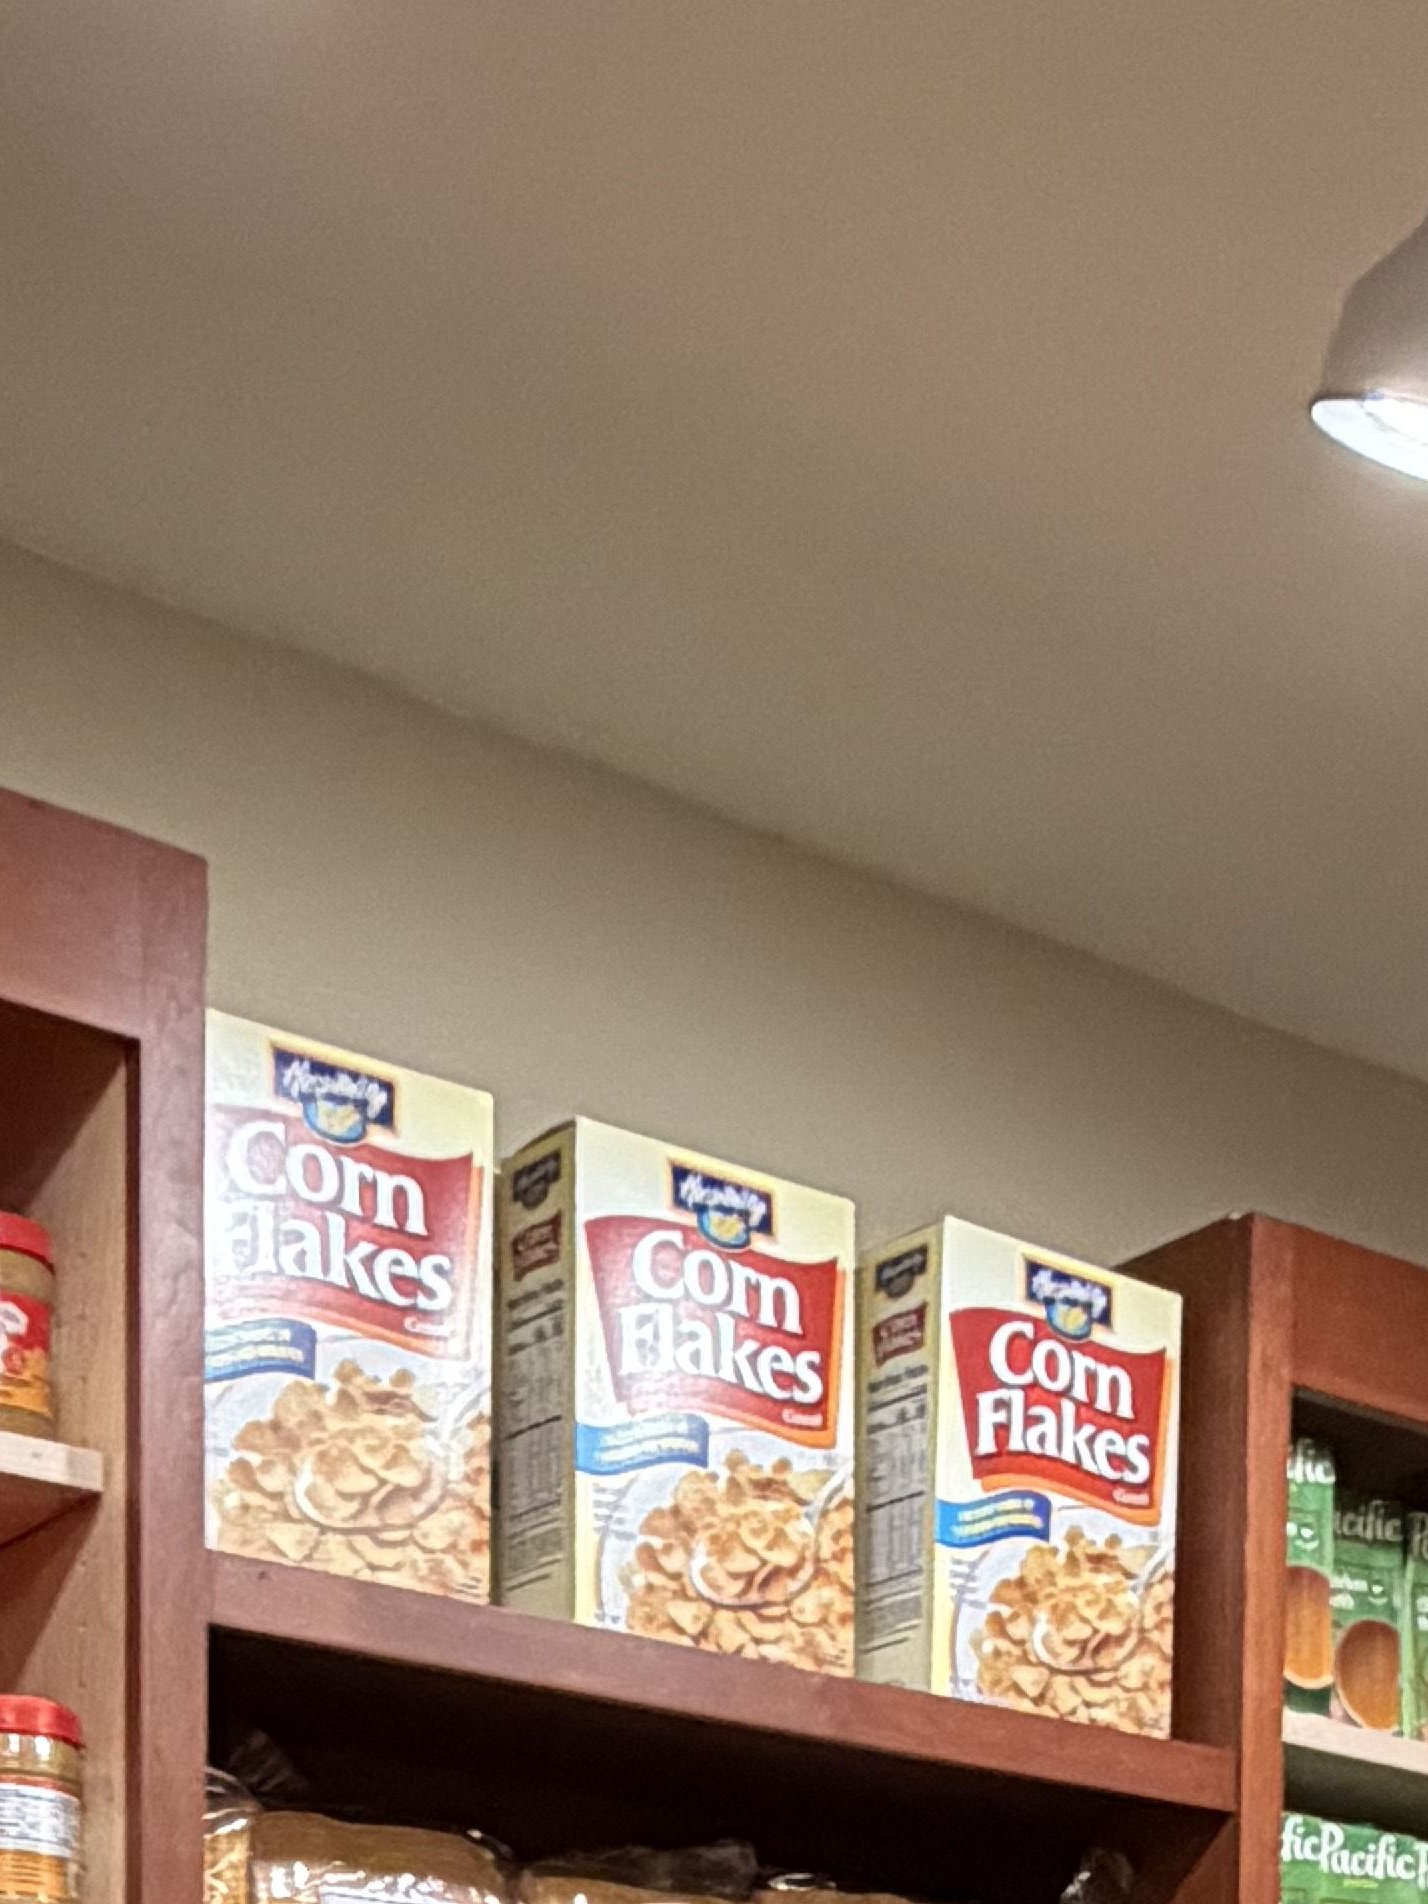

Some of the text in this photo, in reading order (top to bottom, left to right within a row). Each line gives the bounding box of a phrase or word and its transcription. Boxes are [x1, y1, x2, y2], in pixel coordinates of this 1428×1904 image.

[225, 1119, 429, 1237] Corn
[220, 1199, 454, 1313] Flakes
[631, 1229, 803, 1336] Corn
[617, 1301, 825, 1406] Flakes
[988, 1320, 1134, 1420] Corn
[974, 1388, 1152, 1484] Flakes
[1319, 1821, 1416, 1880] Pacific
